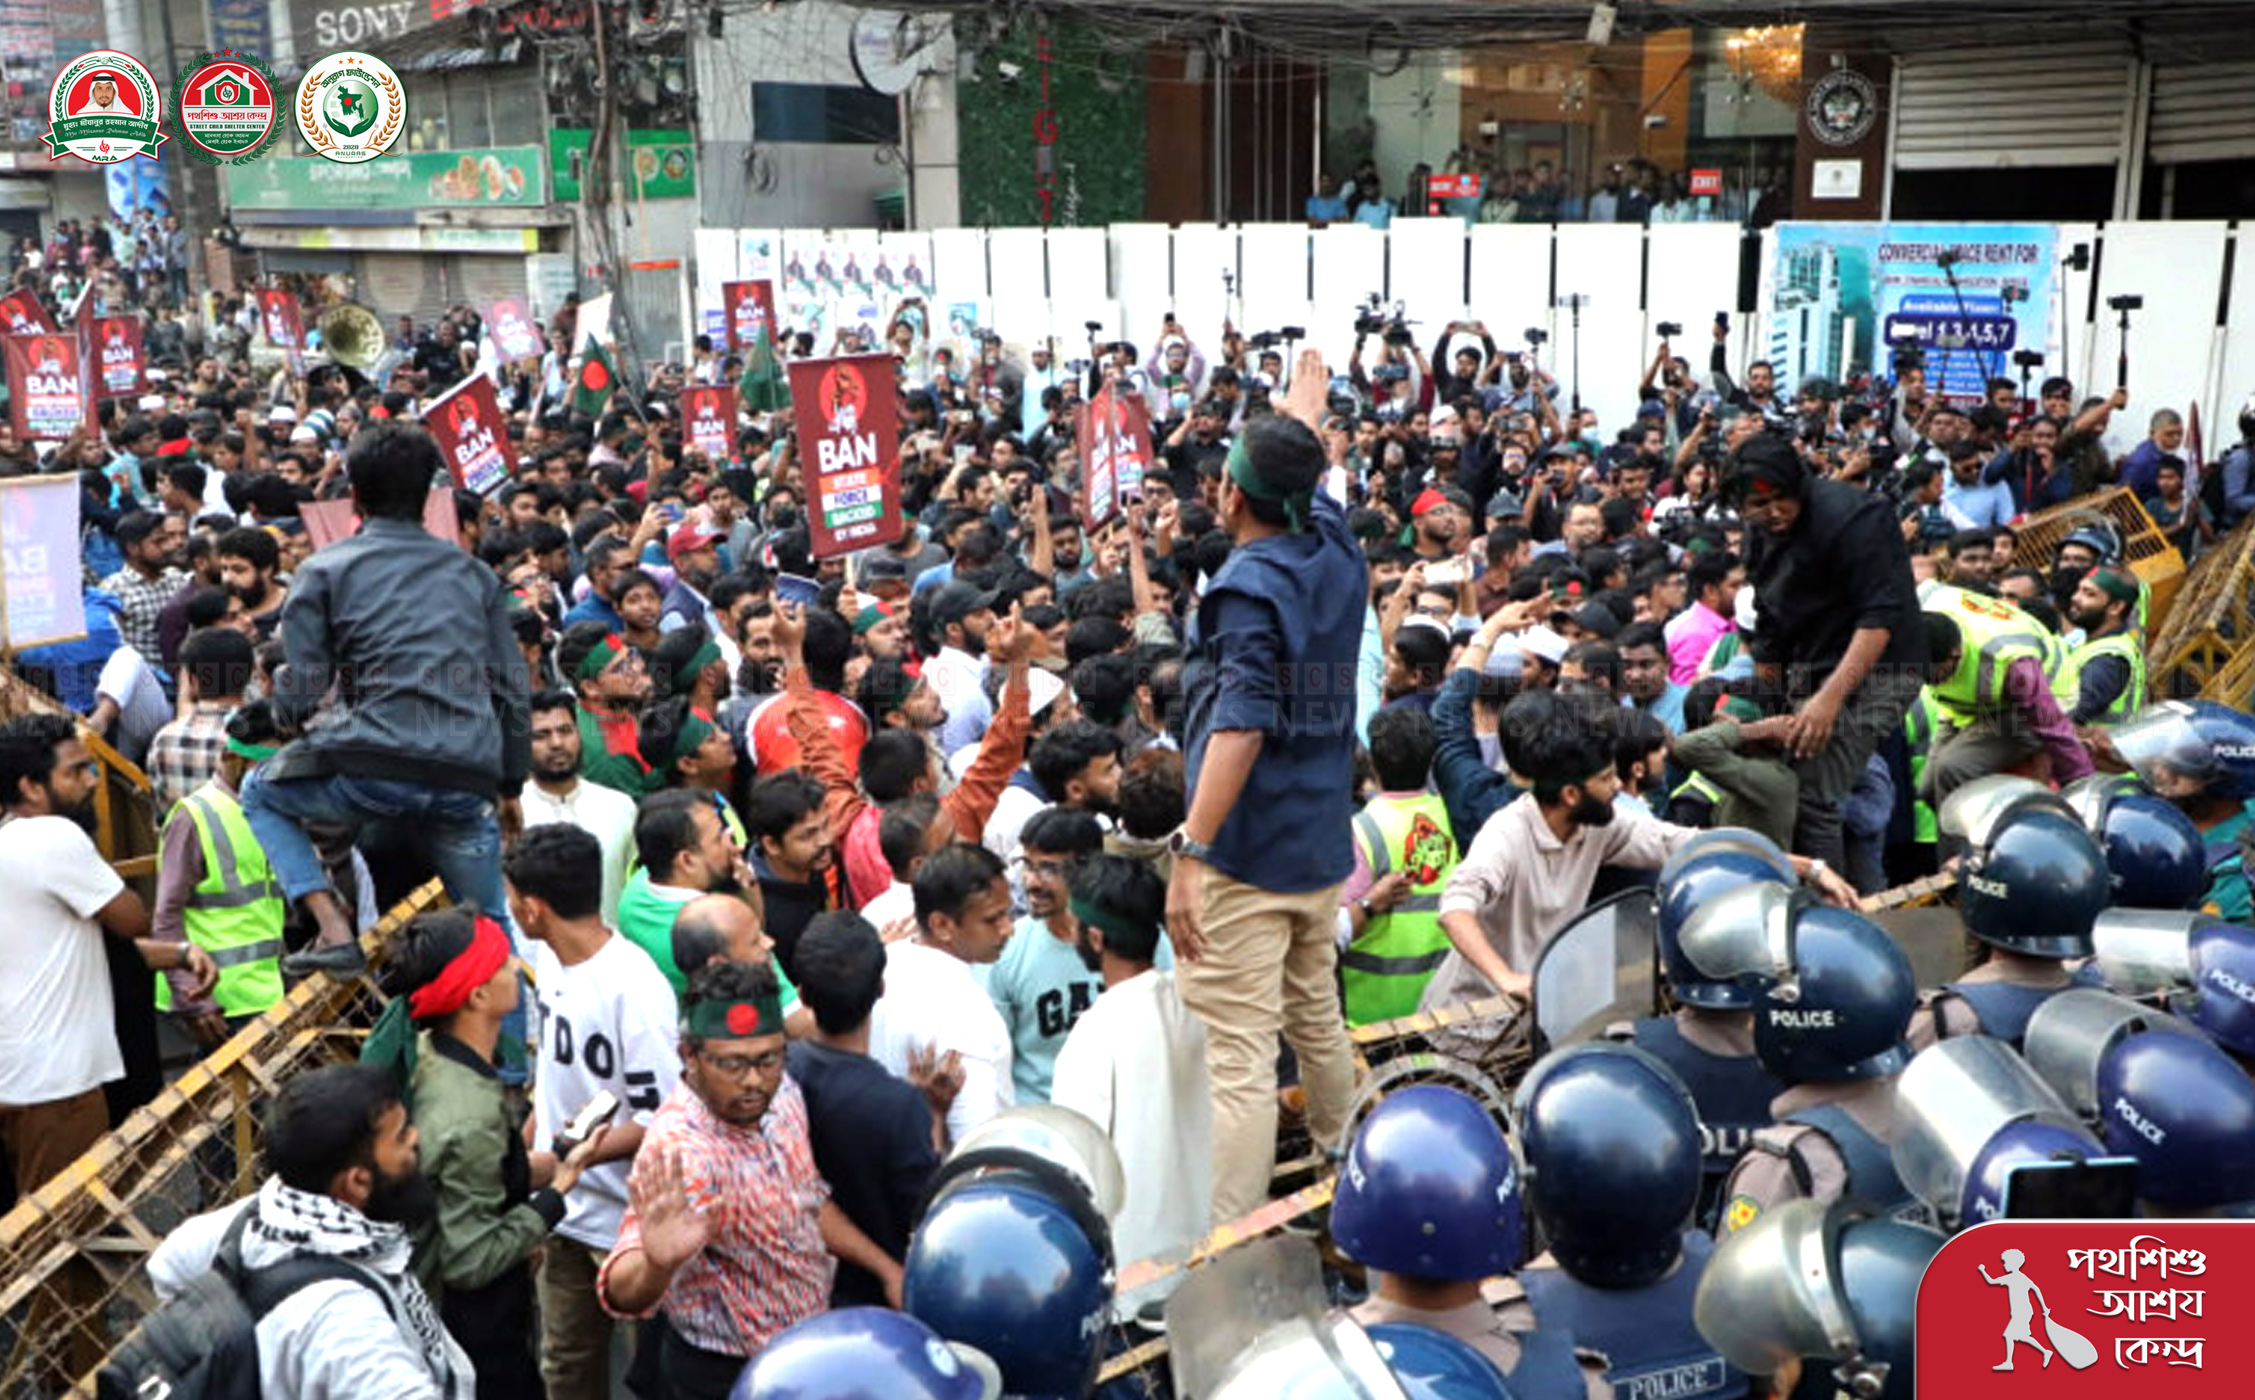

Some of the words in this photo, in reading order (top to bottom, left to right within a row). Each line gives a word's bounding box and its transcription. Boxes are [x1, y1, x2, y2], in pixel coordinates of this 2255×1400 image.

[315, 1, 415, 47] SONY
[102, 345, 133, 363] BAN
[26, 375, 78, 394] BAN
[454, 426, 495, 465] BAN
[818, 432, 877, 473] BAN
[834, 488, 868, 505] FORCE
[1967, 873, 2009, 899] POLICE
[1769, 1008, 1836, 1028] POLICE
[2115, 1097, 2167, 1145] POLICE
[1629, 1362, 1708, 1400] POLICE
